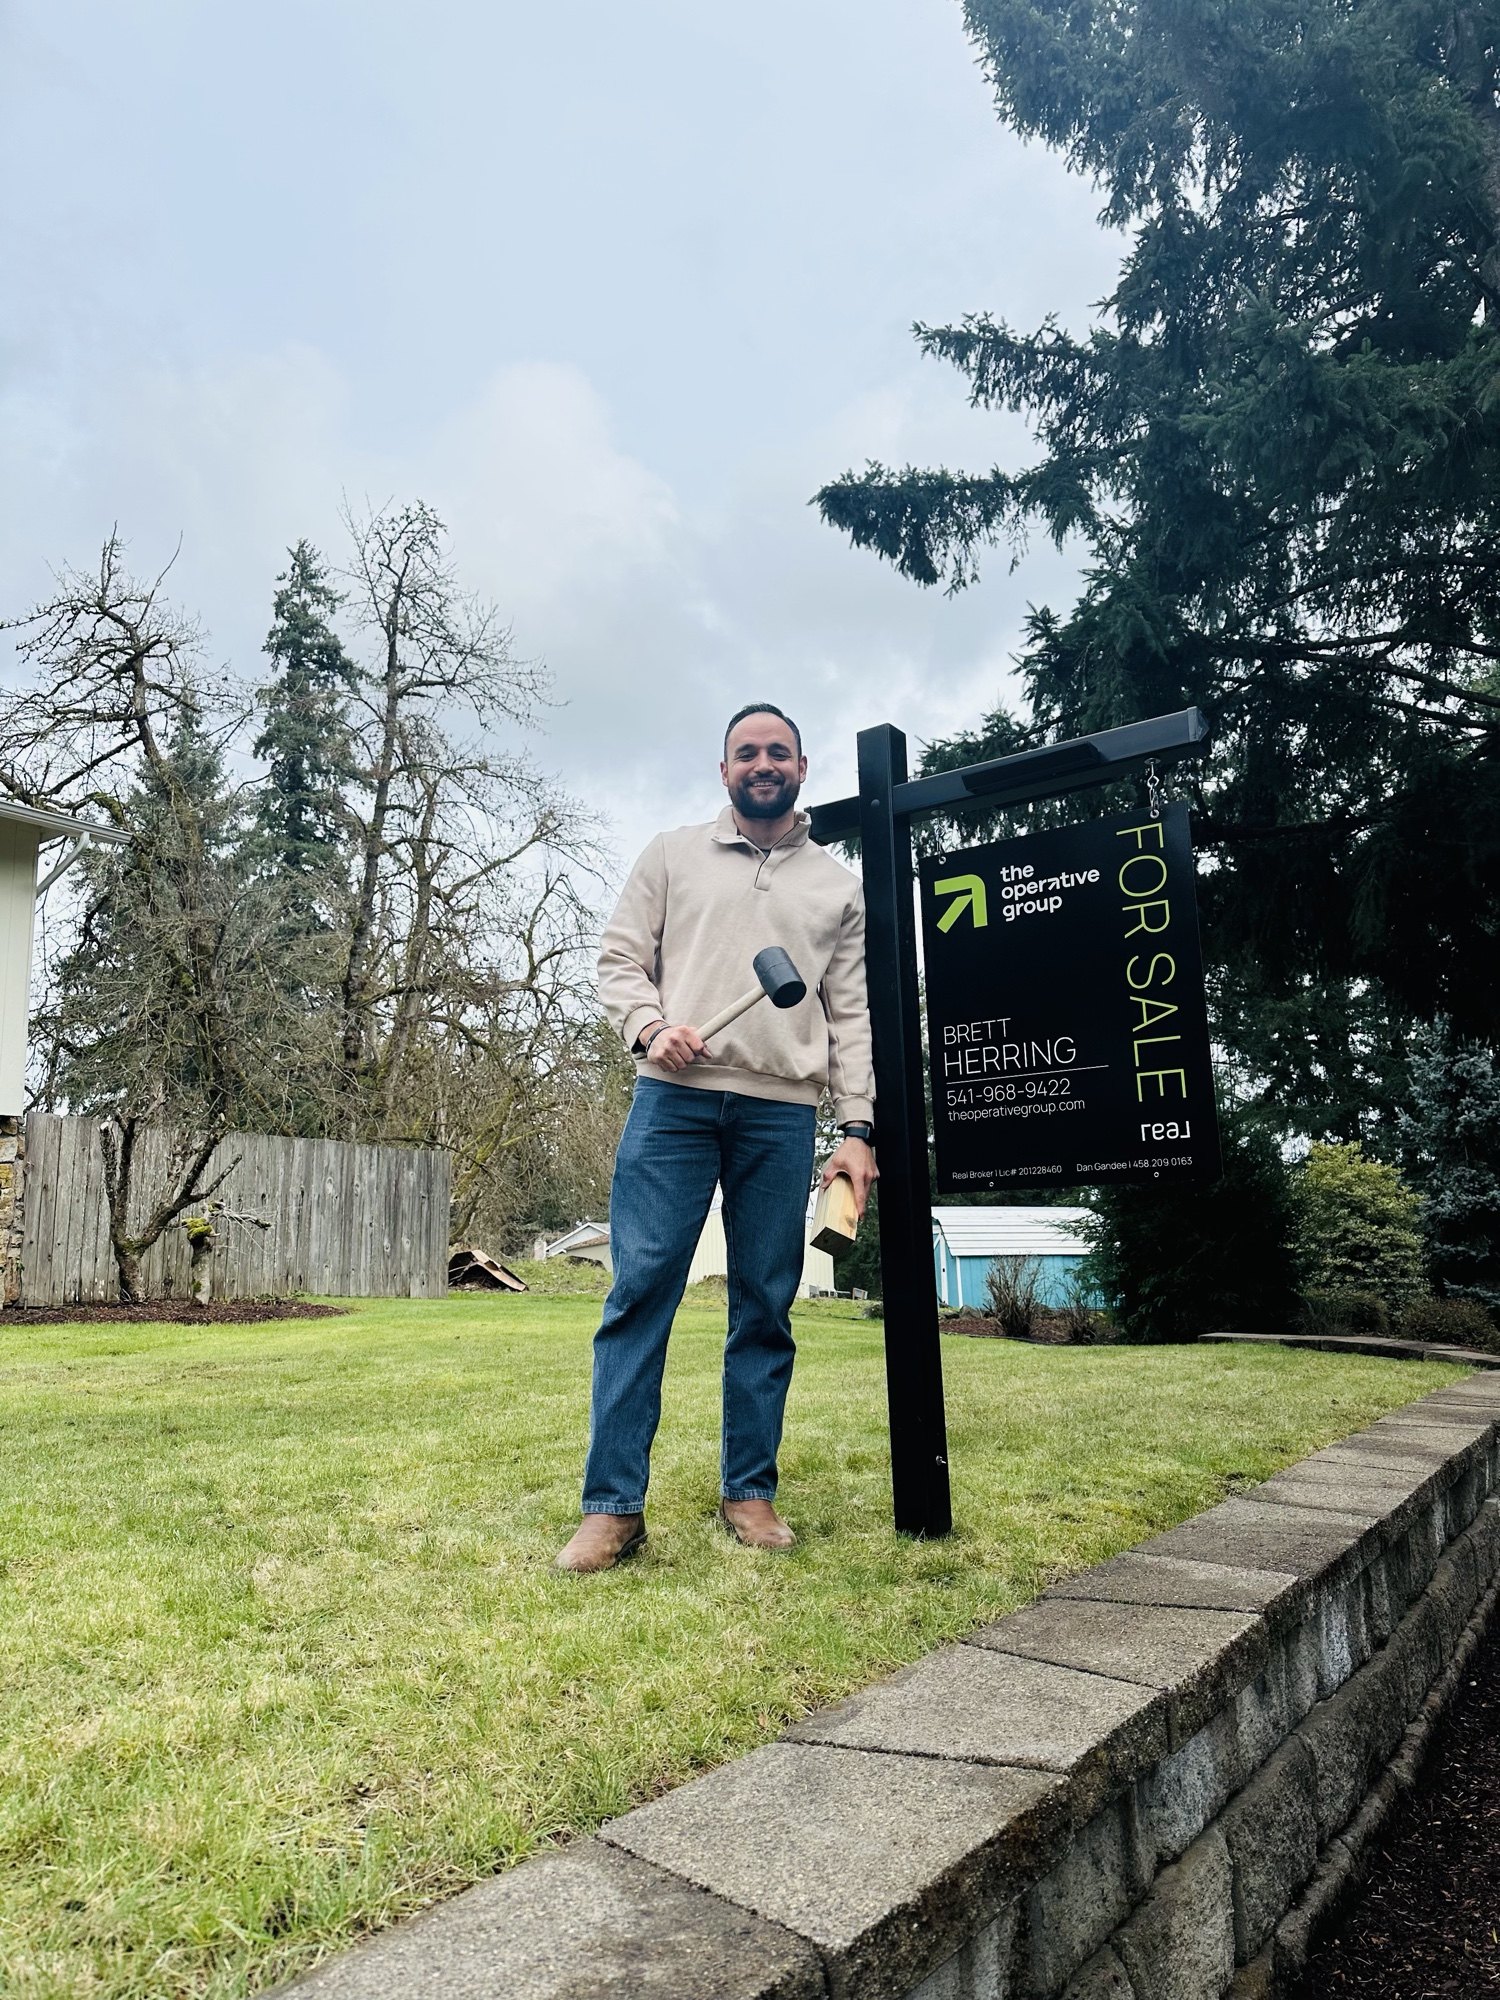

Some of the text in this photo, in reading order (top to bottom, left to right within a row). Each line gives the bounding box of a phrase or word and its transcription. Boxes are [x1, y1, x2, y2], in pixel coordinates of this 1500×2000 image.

[1000, 864, 1035, 883] the
[1002, 893, 1064, 923] group
[1115, 822, 1188, 1103] FOR SALE
[943, 1017, 1012, 1046] BRETT
[944, 1036, 1077, 1078] HERRING
[946, 1077, 1071, 1106] 541-968-9422
[948, 1097, 1086, 1123] theoperativegroup.com
[1140, 1120, 1192, 1143] real
[952, 1171, 969, 1180] Real
[970, 1169, 994, 1179] Broker
[999, 1168, 1017, 1177] Lic#
[1018, 1164, 1063, 1176] 201228460
[1076, 1163, 1093, 1172] Dan
[1094, 1160, 1128, 1171] Gandee
